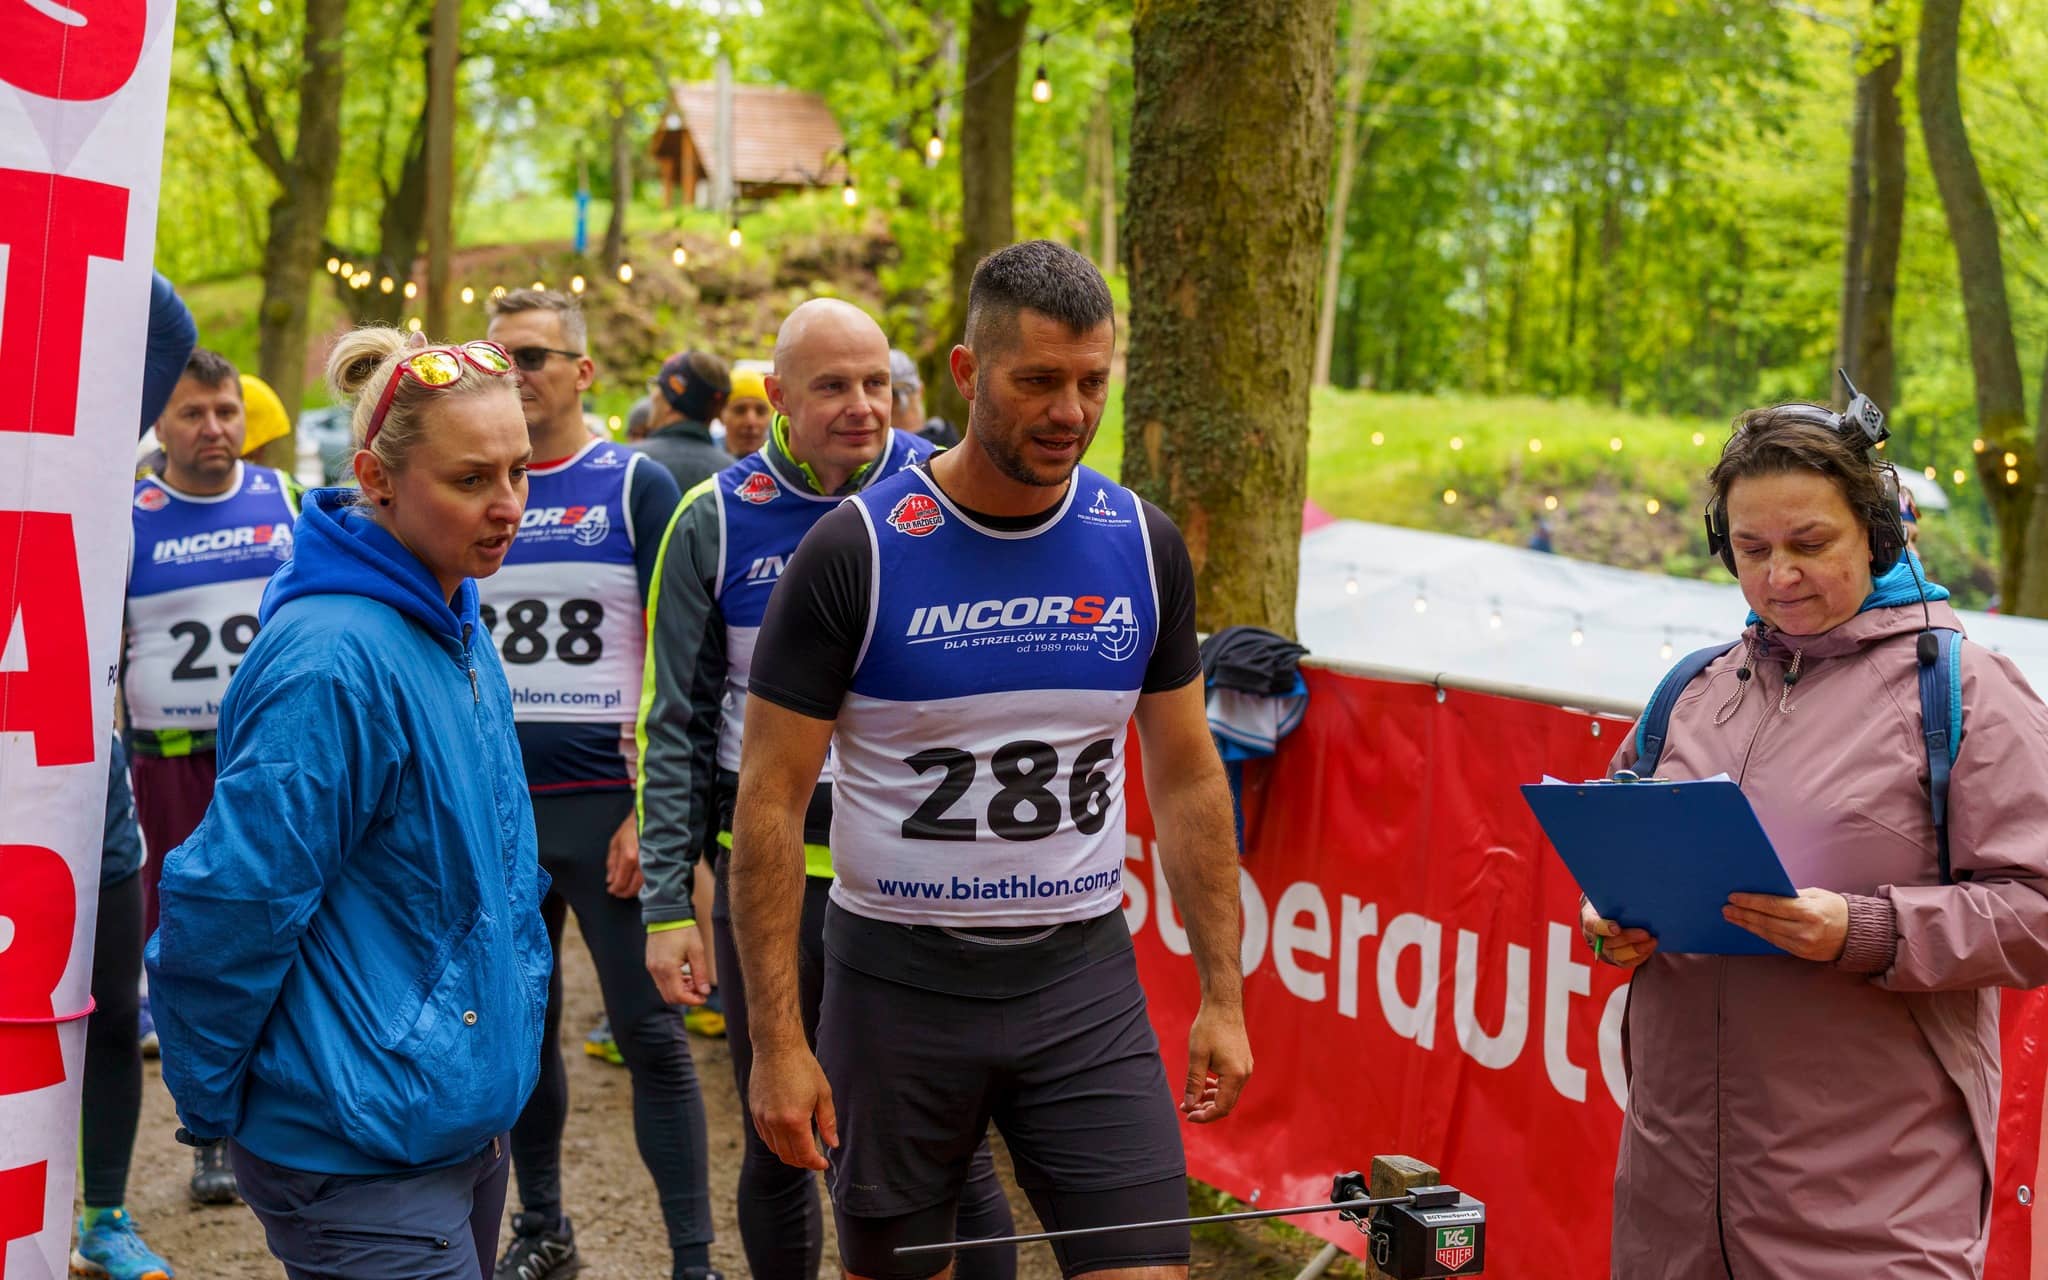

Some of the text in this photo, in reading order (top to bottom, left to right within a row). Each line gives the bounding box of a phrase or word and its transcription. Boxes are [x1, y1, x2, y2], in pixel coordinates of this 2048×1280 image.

[153, 522, 293, 561] INCORSA
[905, 595, 1134, 637] INCORSA
[943, 631, 1099, 650] DLA STRZELCÓW Z PASJĄ
[1016, 643, 1090, 653] od 1989 roku
[901, 738, 1115, 842] 286
[877, 860, 1122, 900] www.biathlon.com.pl
[1443, 1228, 1469, 1247] TAG
[1438, 1248, 1471, 1268] HEUER
